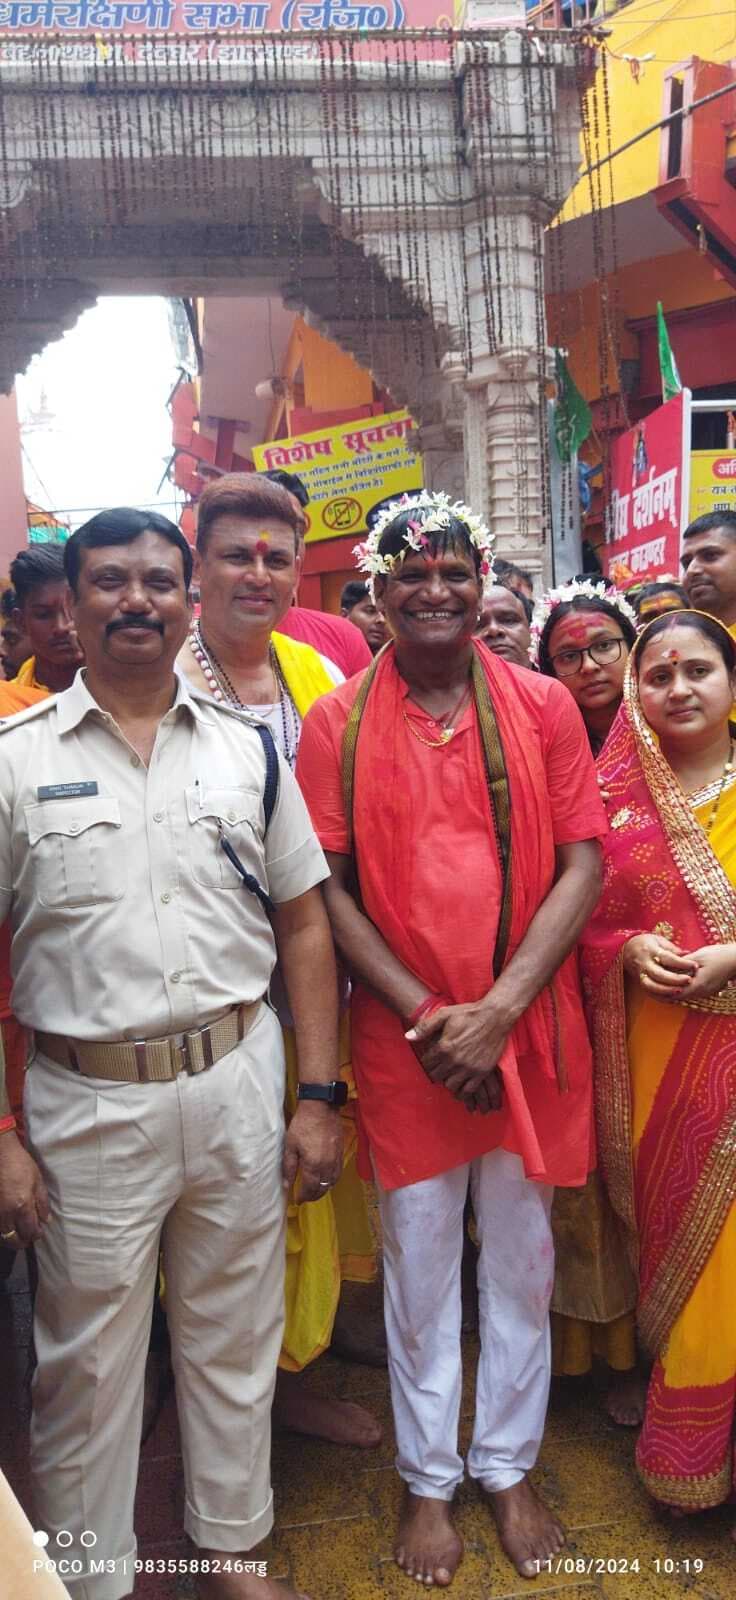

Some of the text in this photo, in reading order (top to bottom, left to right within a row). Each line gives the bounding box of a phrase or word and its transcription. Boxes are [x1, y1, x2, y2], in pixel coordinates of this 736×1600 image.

[184, 2, 269, 29] सभा
[264, 418, 413, 470] विशेष सूचना
[632, 466, 678, 529] दर्शनम्
